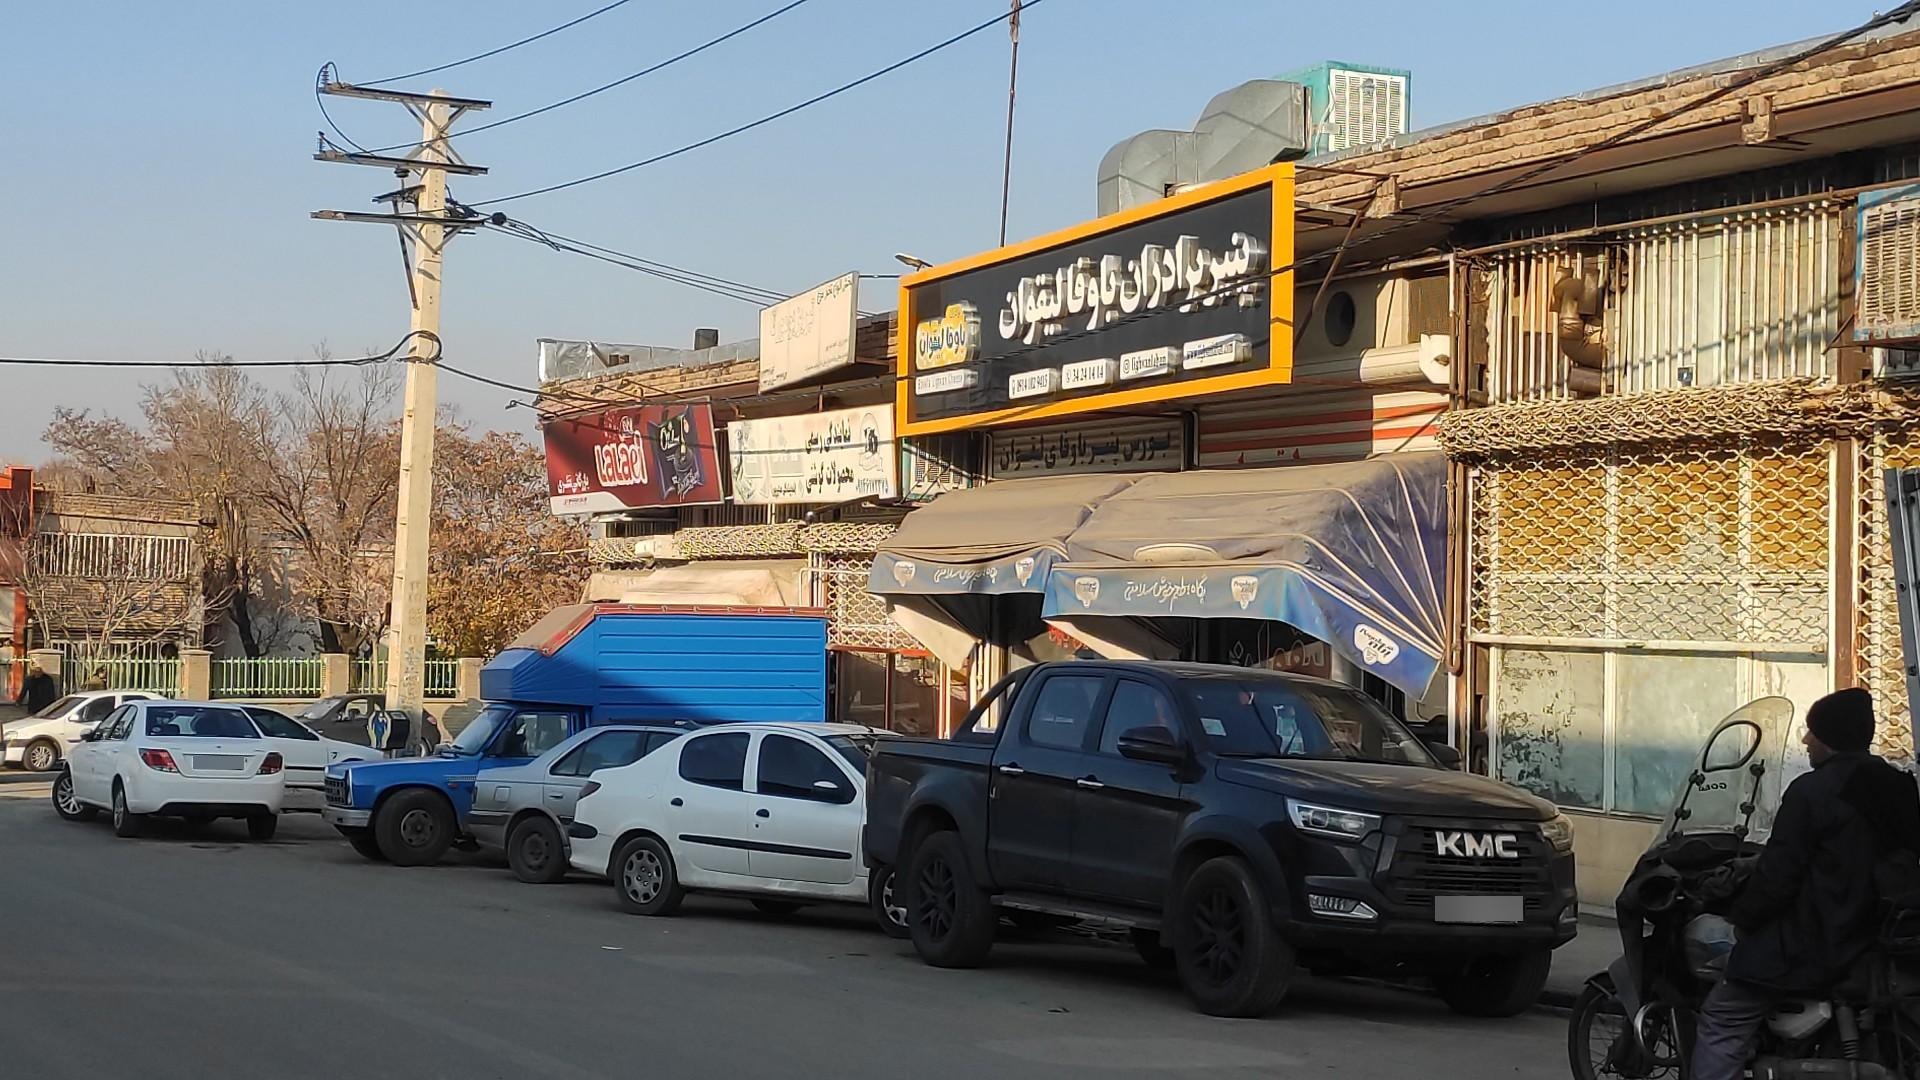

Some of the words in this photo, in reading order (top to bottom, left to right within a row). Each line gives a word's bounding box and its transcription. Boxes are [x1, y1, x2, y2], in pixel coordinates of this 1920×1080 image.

[1067, 255, 1121, 330] باوفا
[1120, 235, 1208, 313] برادران
[1203, 232, 1258, 310] پنیر
[999, 267, 1064, 344] لیقوان
[1000, 432, 1044, 471] لیقوان
[1088, 432, 1120, 466] پنیر
[1124, 581, 1154, 601] سلامتی
[1435, 831, 1518, 858] KMC
